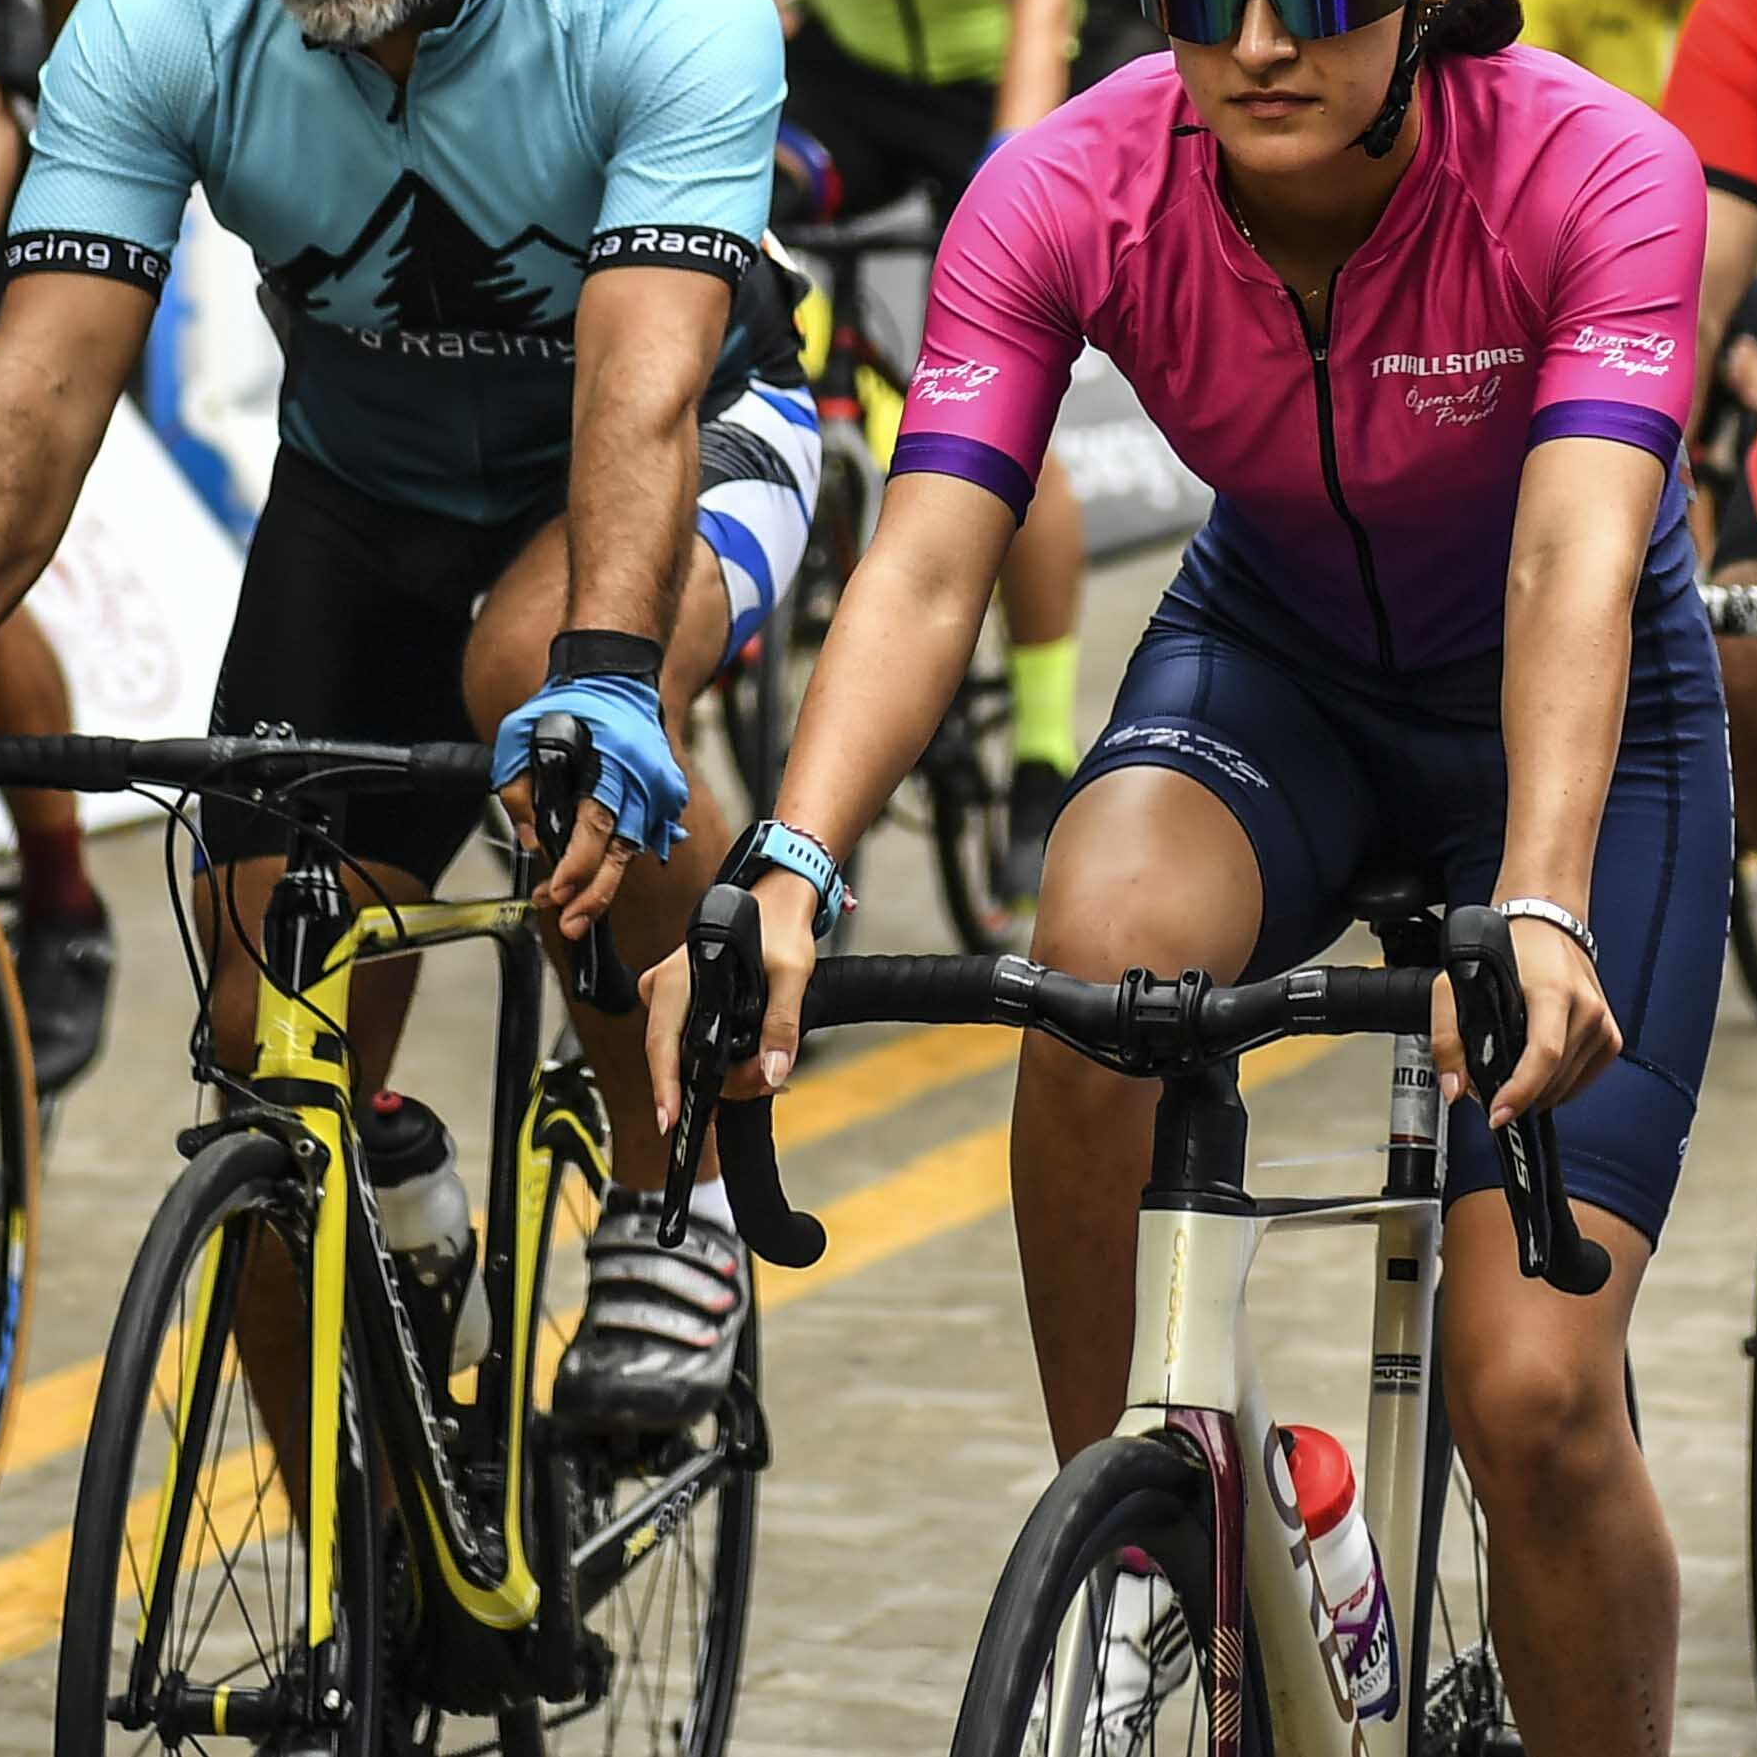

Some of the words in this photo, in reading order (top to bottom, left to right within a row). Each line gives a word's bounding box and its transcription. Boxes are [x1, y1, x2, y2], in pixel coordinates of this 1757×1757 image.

[5, 234, 110, 271] acing
[1370, 346, 1525, 379] TRIALLSTARS
[1382, 1368, 1408, 1381] UCI
